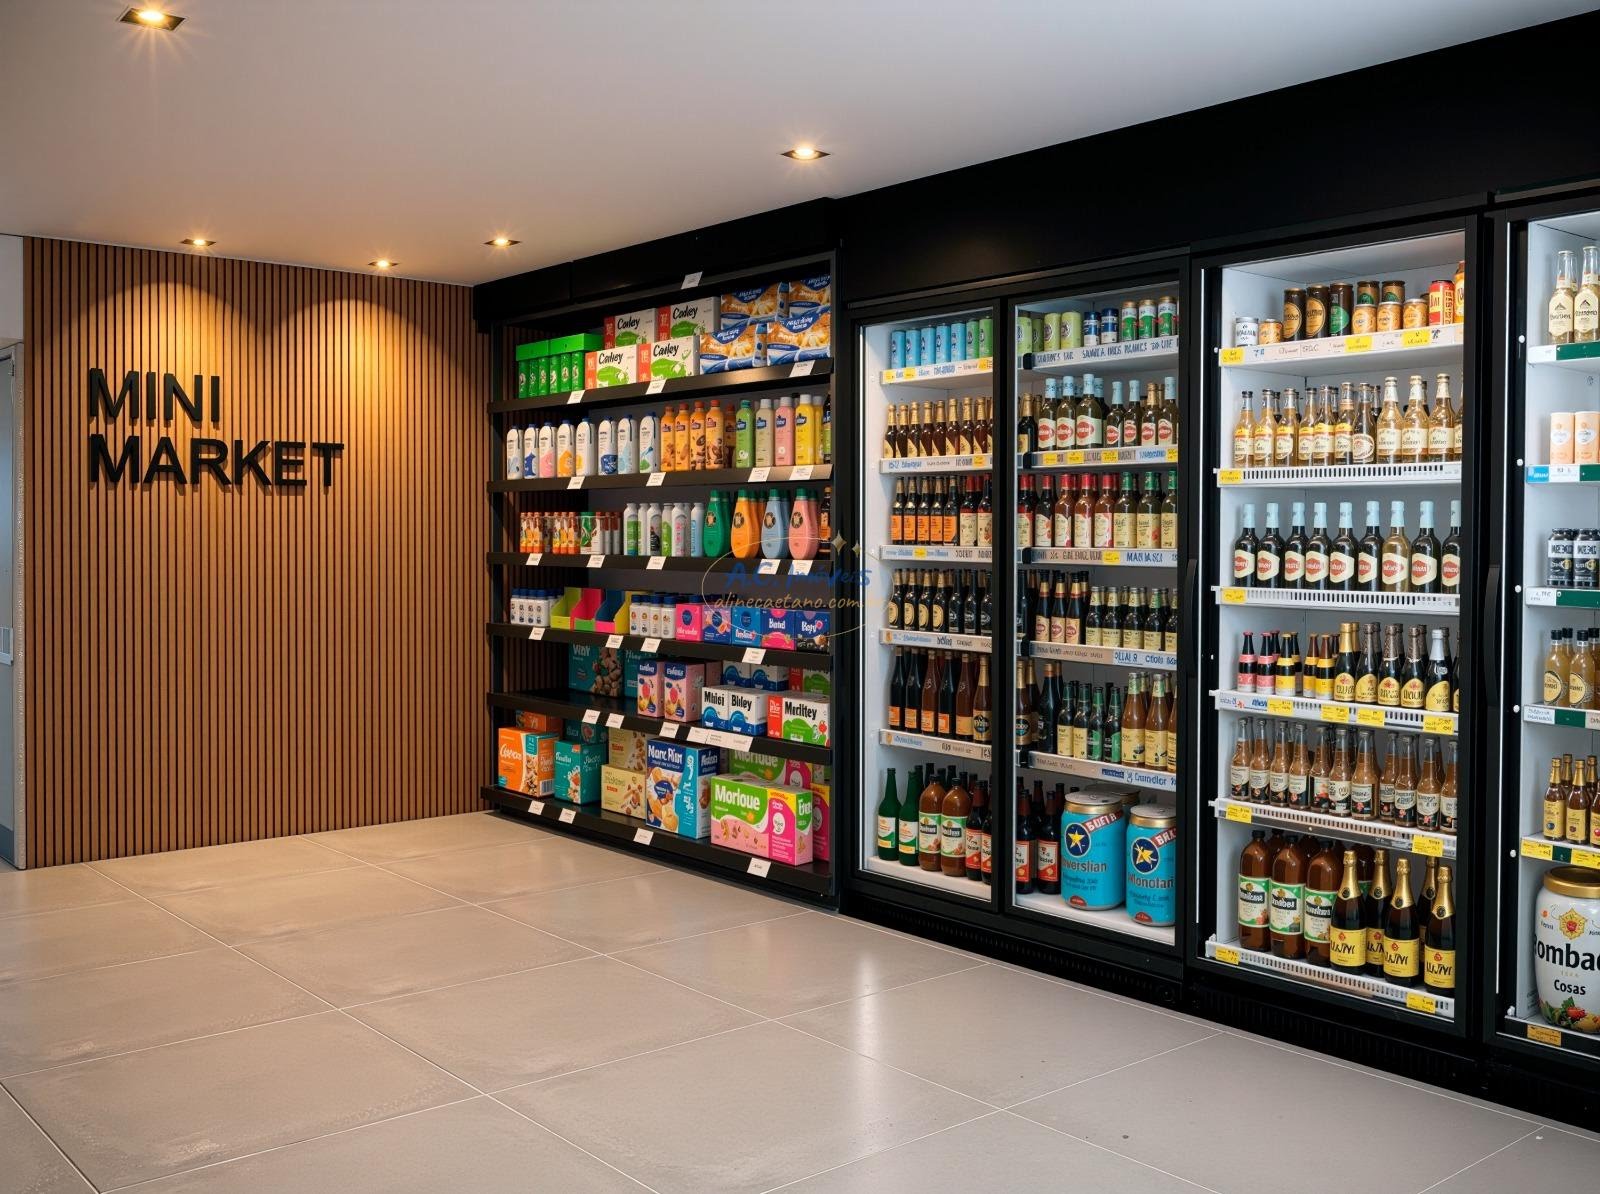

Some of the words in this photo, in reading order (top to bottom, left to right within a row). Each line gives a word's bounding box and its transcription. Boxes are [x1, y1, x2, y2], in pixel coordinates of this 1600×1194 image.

[88, 367, 220, 424] MINI
[88, 433, 345, 488] MARKET
[1553, 978, 1587, 996] Cosas
